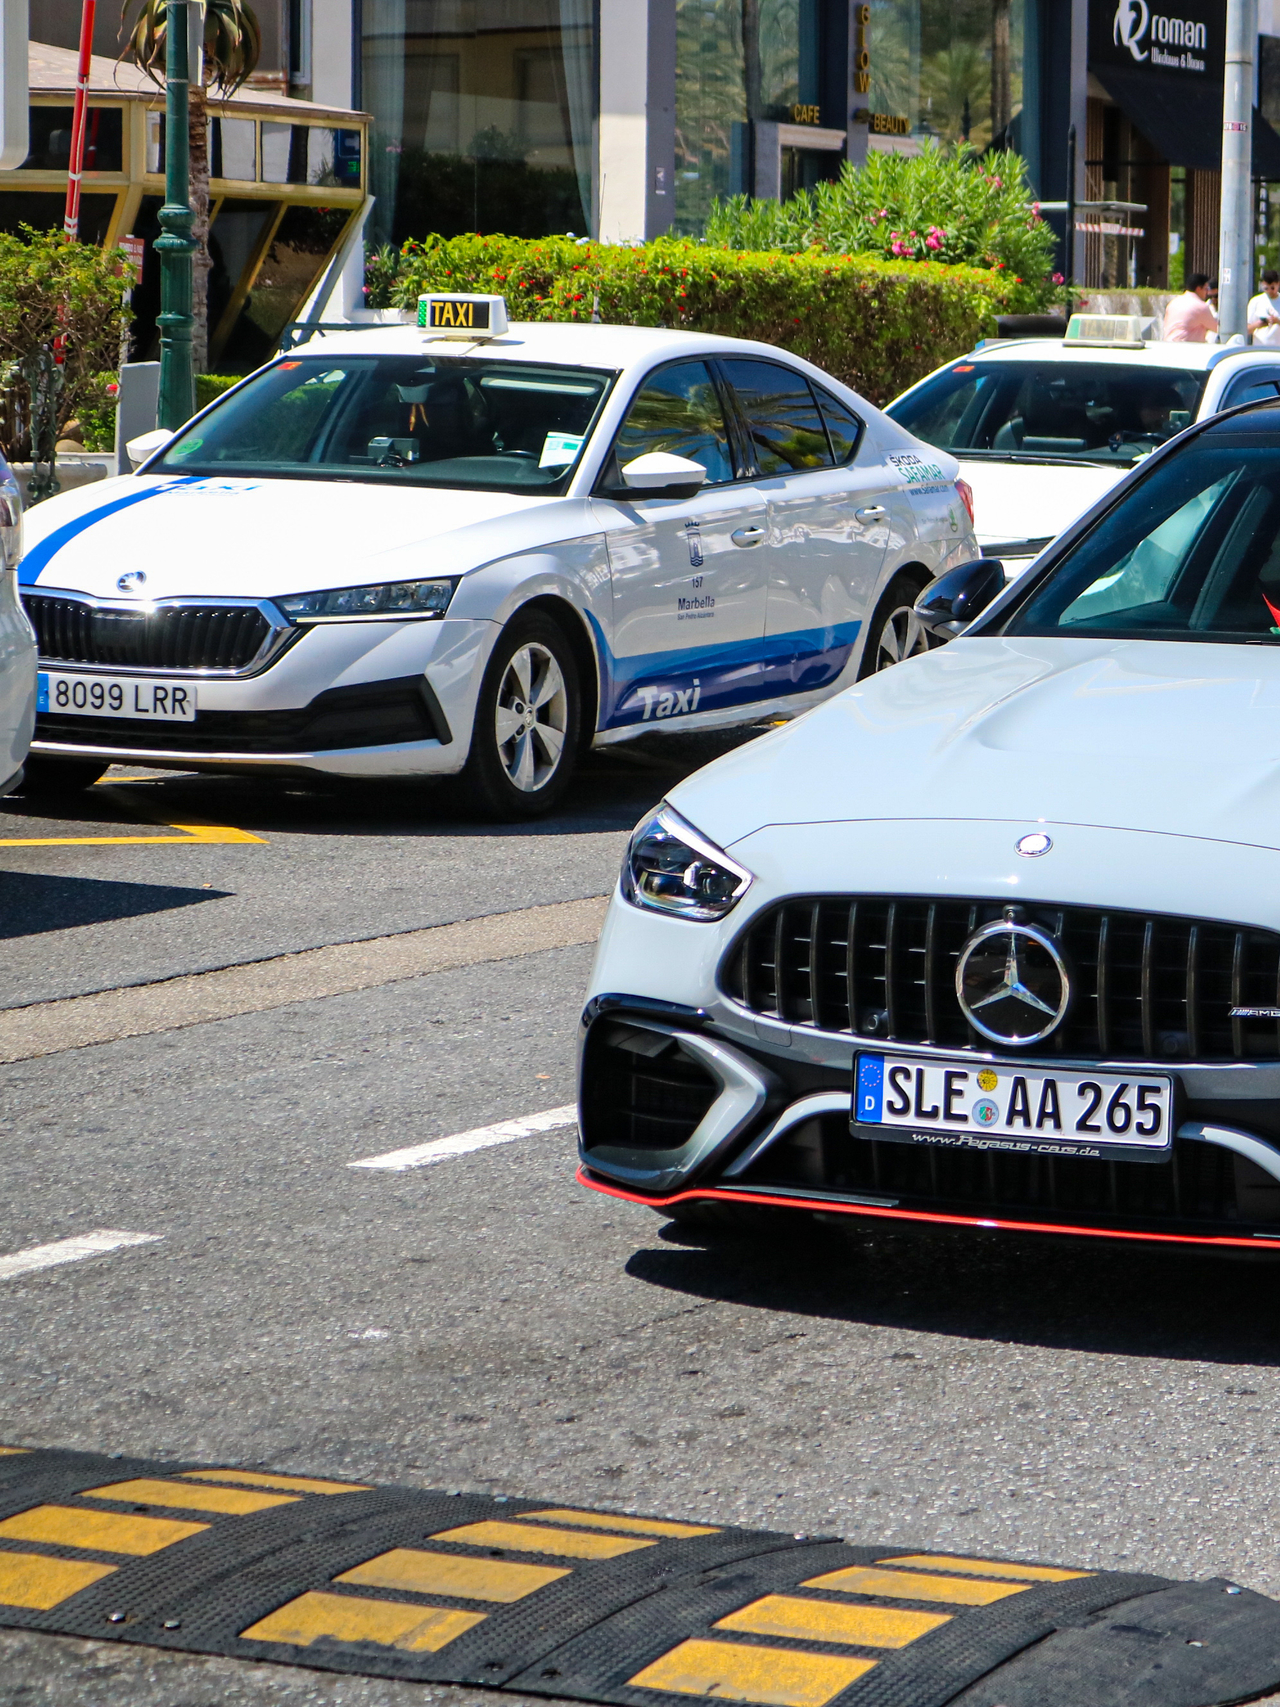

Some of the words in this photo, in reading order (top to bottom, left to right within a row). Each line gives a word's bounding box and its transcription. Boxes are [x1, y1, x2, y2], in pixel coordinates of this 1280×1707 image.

[1151, 14, 1206, 49] roman
[794, 104, 820, 124] CAFE
[873, 113, 910, 134] BEAUTY
[432, 302, 473, 327] TAXI
[898, 464, 946, 484] SAFAMAR
[678, 596, 715, 610] Marbella
[39, 696, 44, 704] E
[56, 680, 123, 711] 8099
[134, 684, 187, 715] LRR
[636, 679, 701, 720] Taxi
[865, 1095, 875, 1111] D
[886, 1066, 969, 1123] SLE
[1005, 1075, 1062, 1131] AA
[1075, 1081, 1162, 1136] 265
[912, 1133, 1100, 1157] www.Pegasus-cars.de
